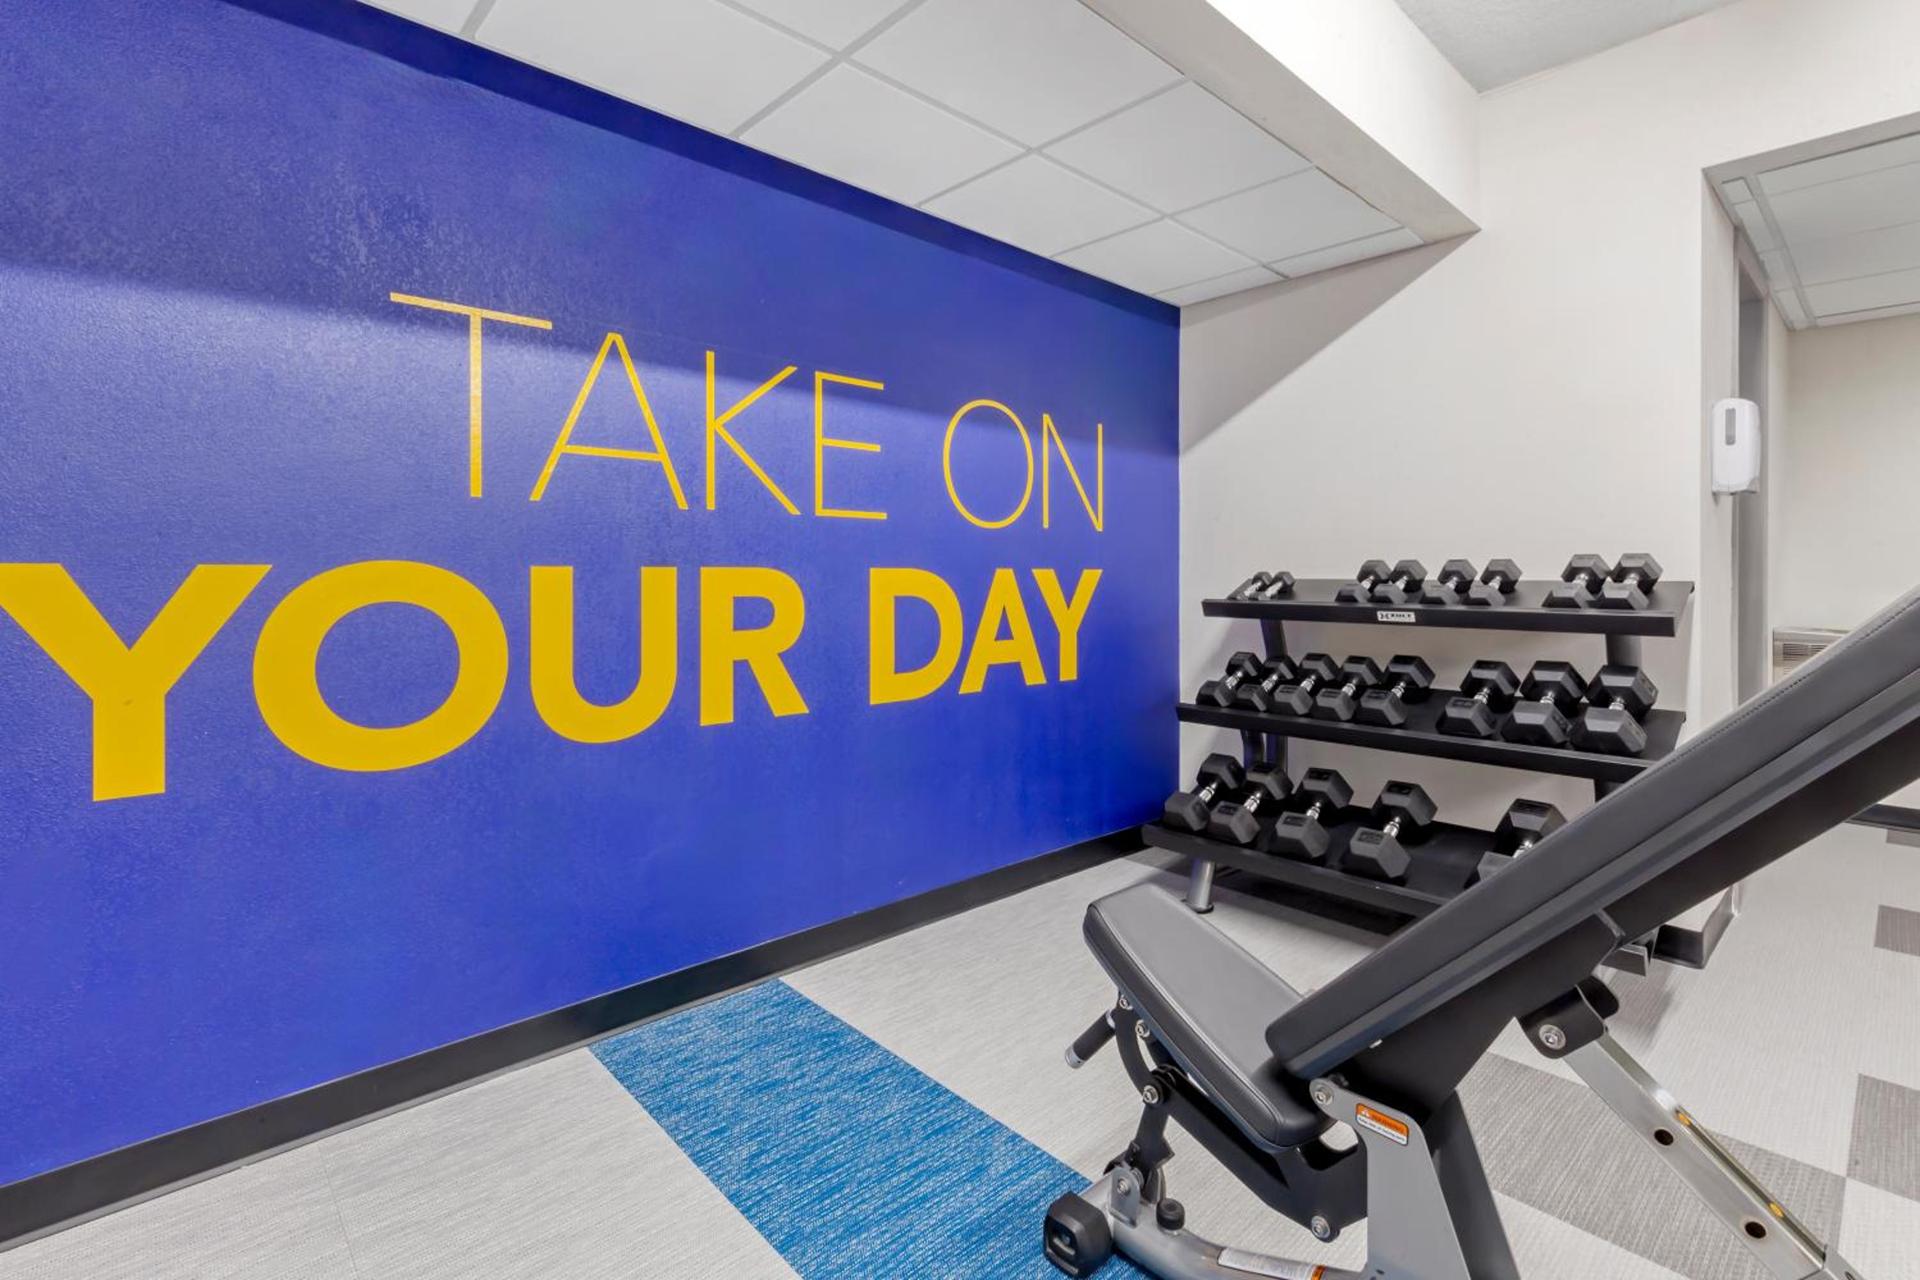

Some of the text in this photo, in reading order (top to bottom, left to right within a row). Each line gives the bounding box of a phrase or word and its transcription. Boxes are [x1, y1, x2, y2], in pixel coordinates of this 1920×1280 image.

[390, 292, 1104, 532] TAKE ON
[0, 559, 1103, 802] YOUR DAY
